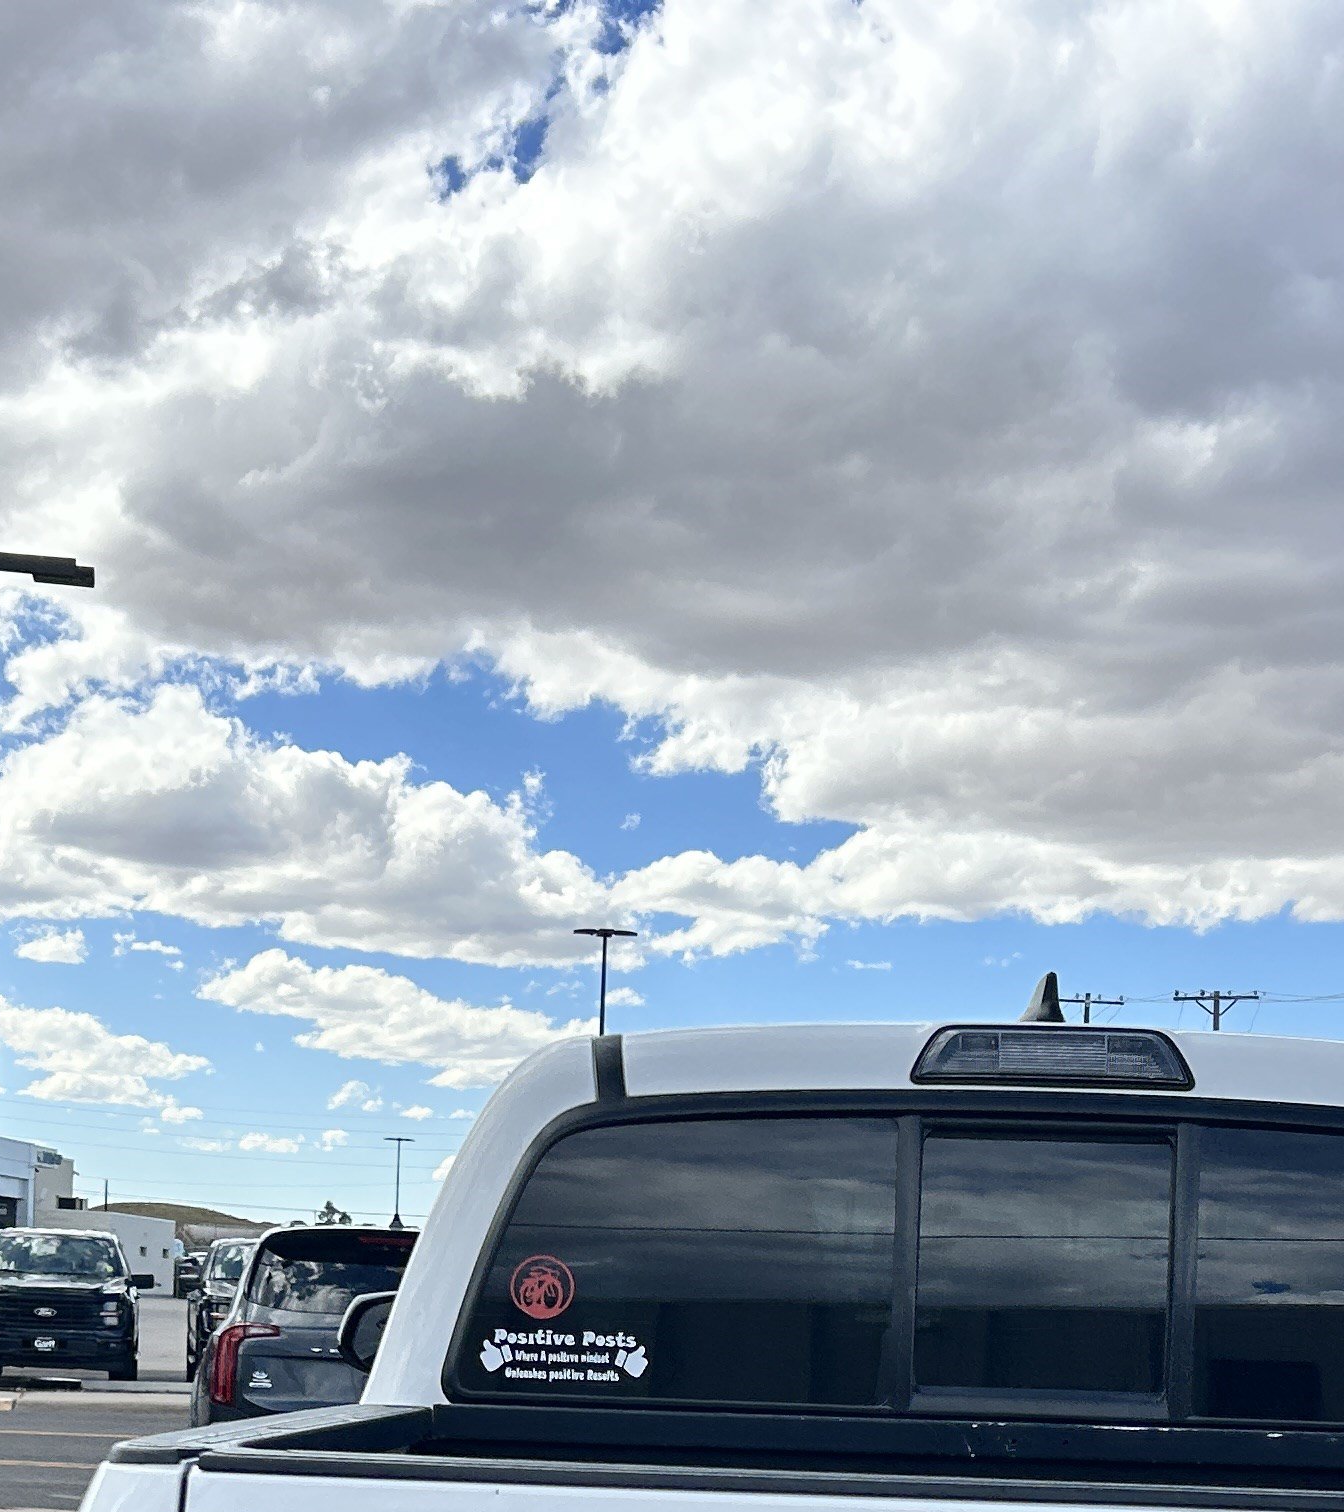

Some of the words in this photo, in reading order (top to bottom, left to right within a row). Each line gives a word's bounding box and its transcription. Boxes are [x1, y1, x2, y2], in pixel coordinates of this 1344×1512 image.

[494, 1328, 575, 1346] Positive
[582, 1331, 637, 1348] Posts
[515, 1350, 538, 1362] Where
[505, 1367, 547, 1380] Unleashes
[549, 1368, 585, 1382] positive
[586, 1369, 620, 1382] Results
